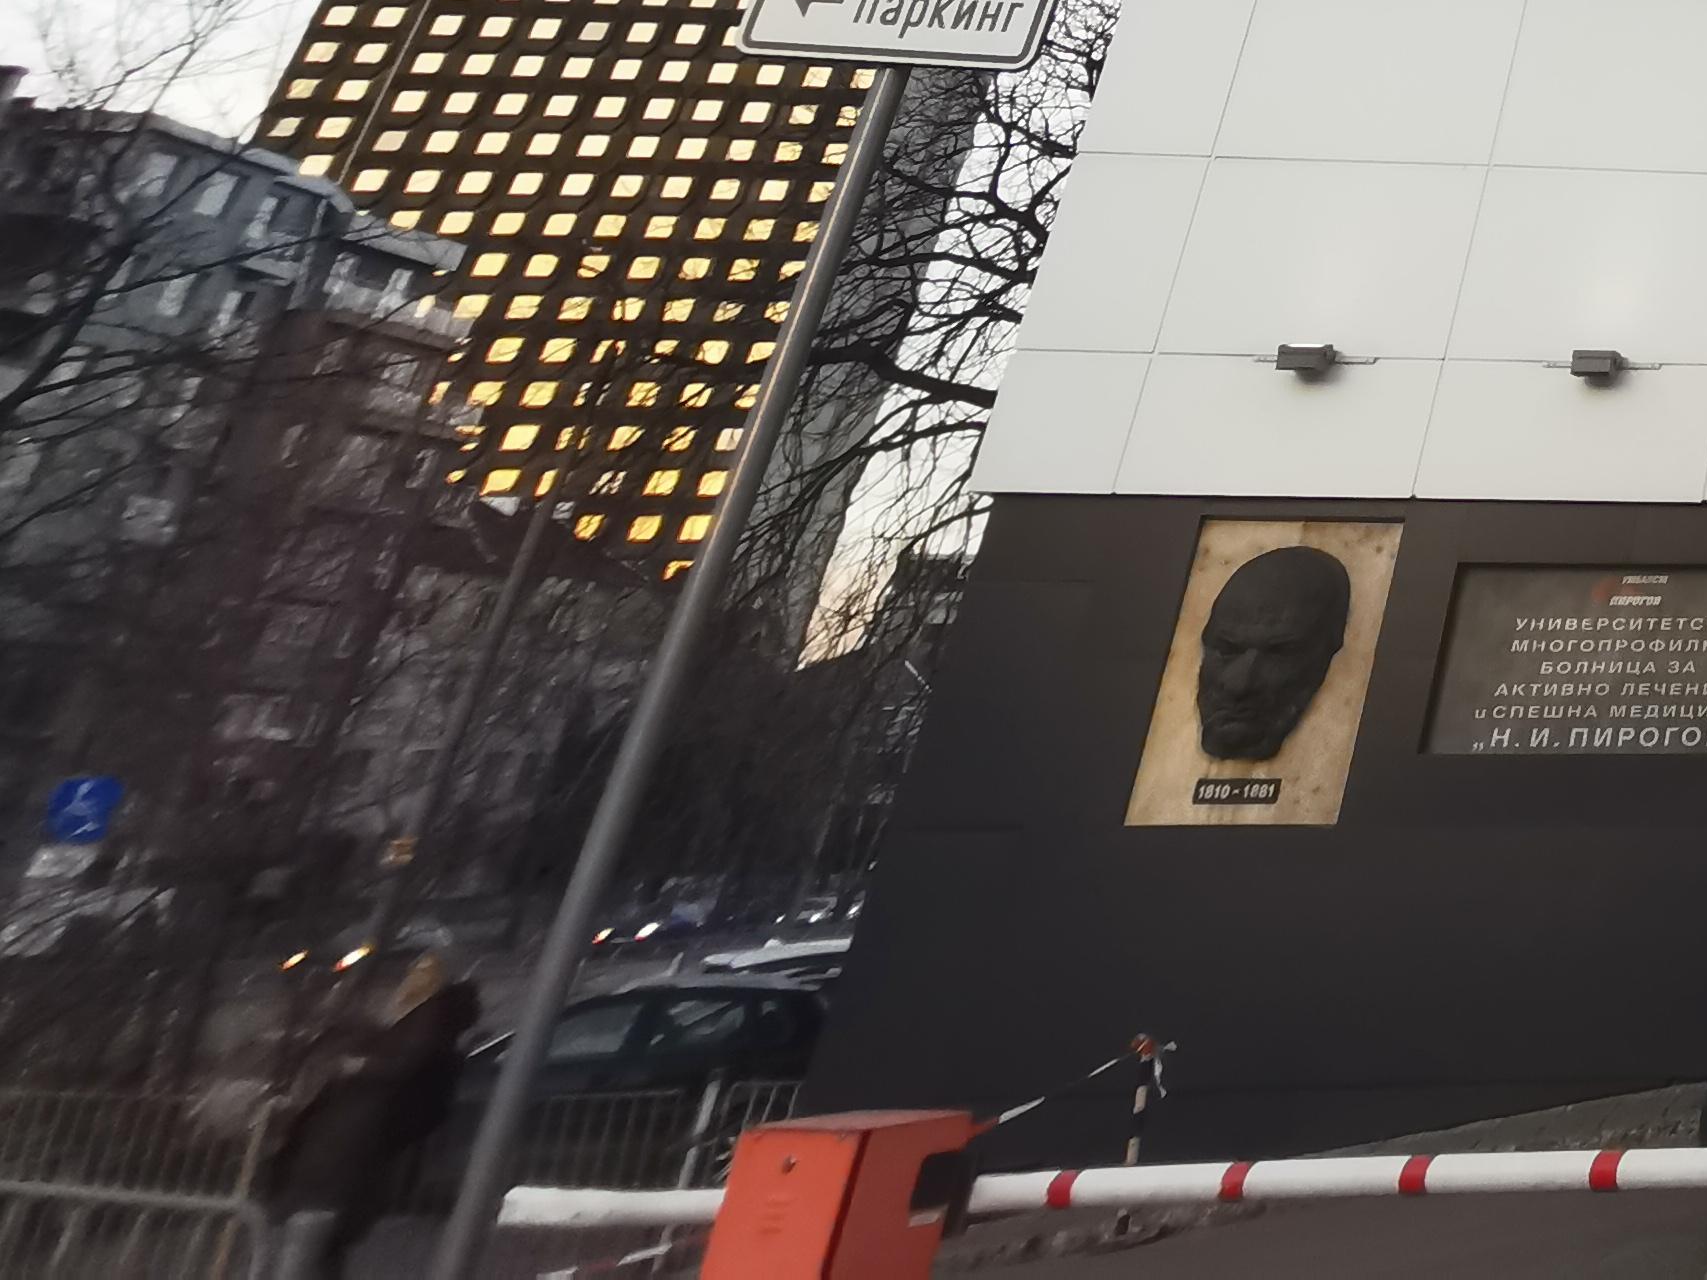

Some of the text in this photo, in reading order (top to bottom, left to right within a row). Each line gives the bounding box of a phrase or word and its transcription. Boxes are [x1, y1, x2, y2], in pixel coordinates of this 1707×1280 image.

[1539, 660, 1696, 676] БОЛНИЦА ЗА
[1493, 683, 1611, 697] АКТИВНО
[1491, 705, 1598, 719] СПЕШНА
